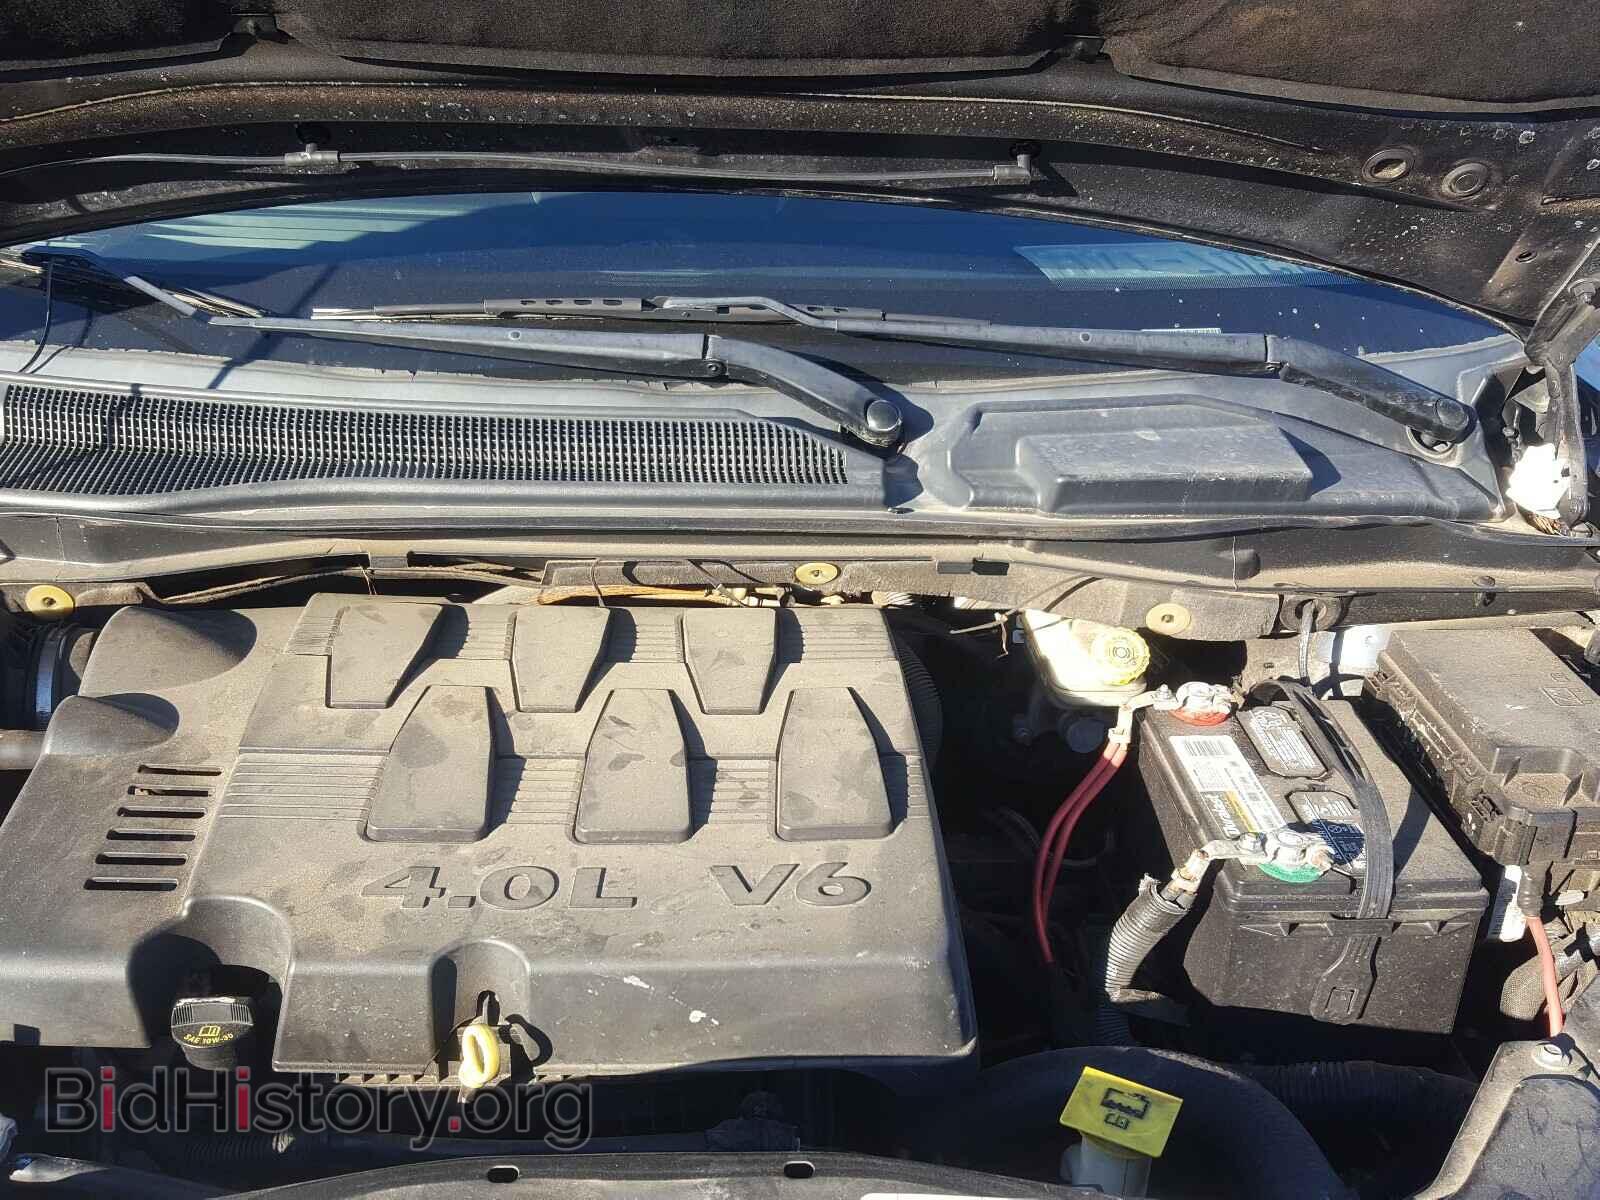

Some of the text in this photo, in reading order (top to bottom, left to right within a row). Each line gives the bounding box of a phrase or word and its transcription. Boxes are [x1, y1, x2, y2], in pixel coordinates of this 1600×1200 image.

[360, 861, 873, 910] 4.0L V6
[183, 1032, 234, 1045] SAE 10W-30
